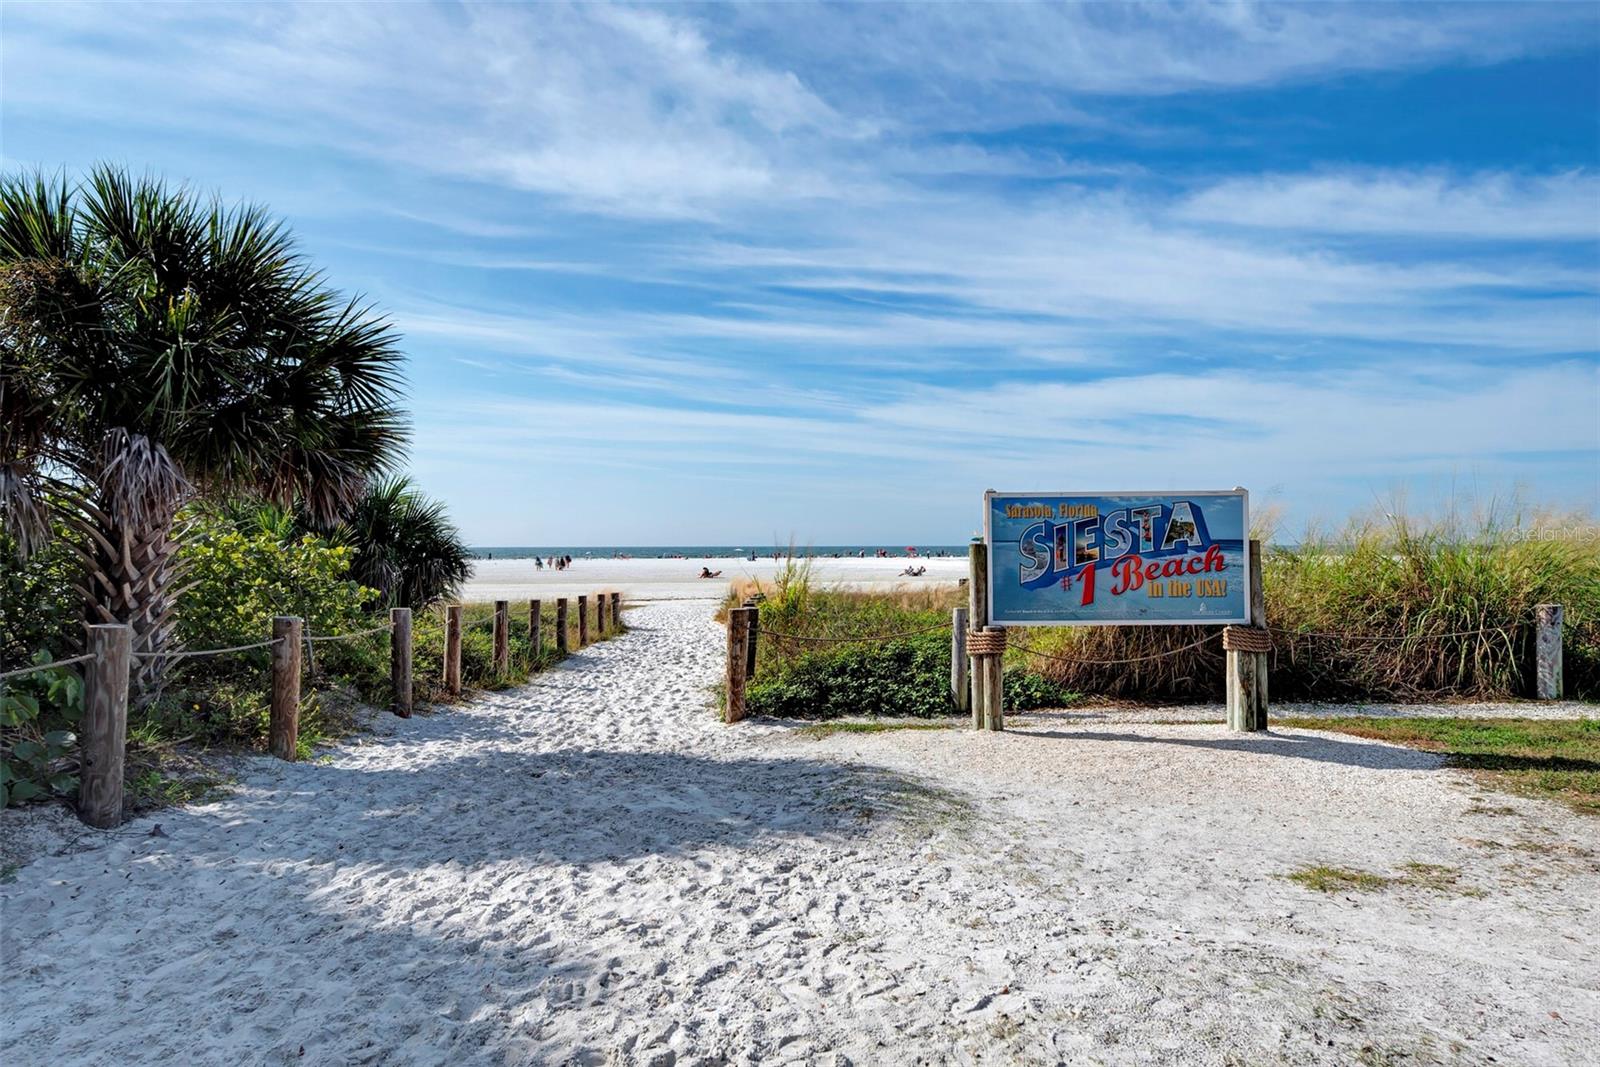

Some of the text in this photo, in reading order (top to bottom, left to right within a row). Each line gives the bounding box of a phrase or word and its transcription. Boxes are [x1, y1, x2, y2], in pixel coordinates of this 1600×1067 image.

[1059, 503, 1098, 517] Florida
[1019, 501, 1203, 585] SIESTA
[1061, 562, 1096, 606] #1
[1110, 543, 1229, 596] Beach
[1147, 577, 1228, 598] in the USA!
